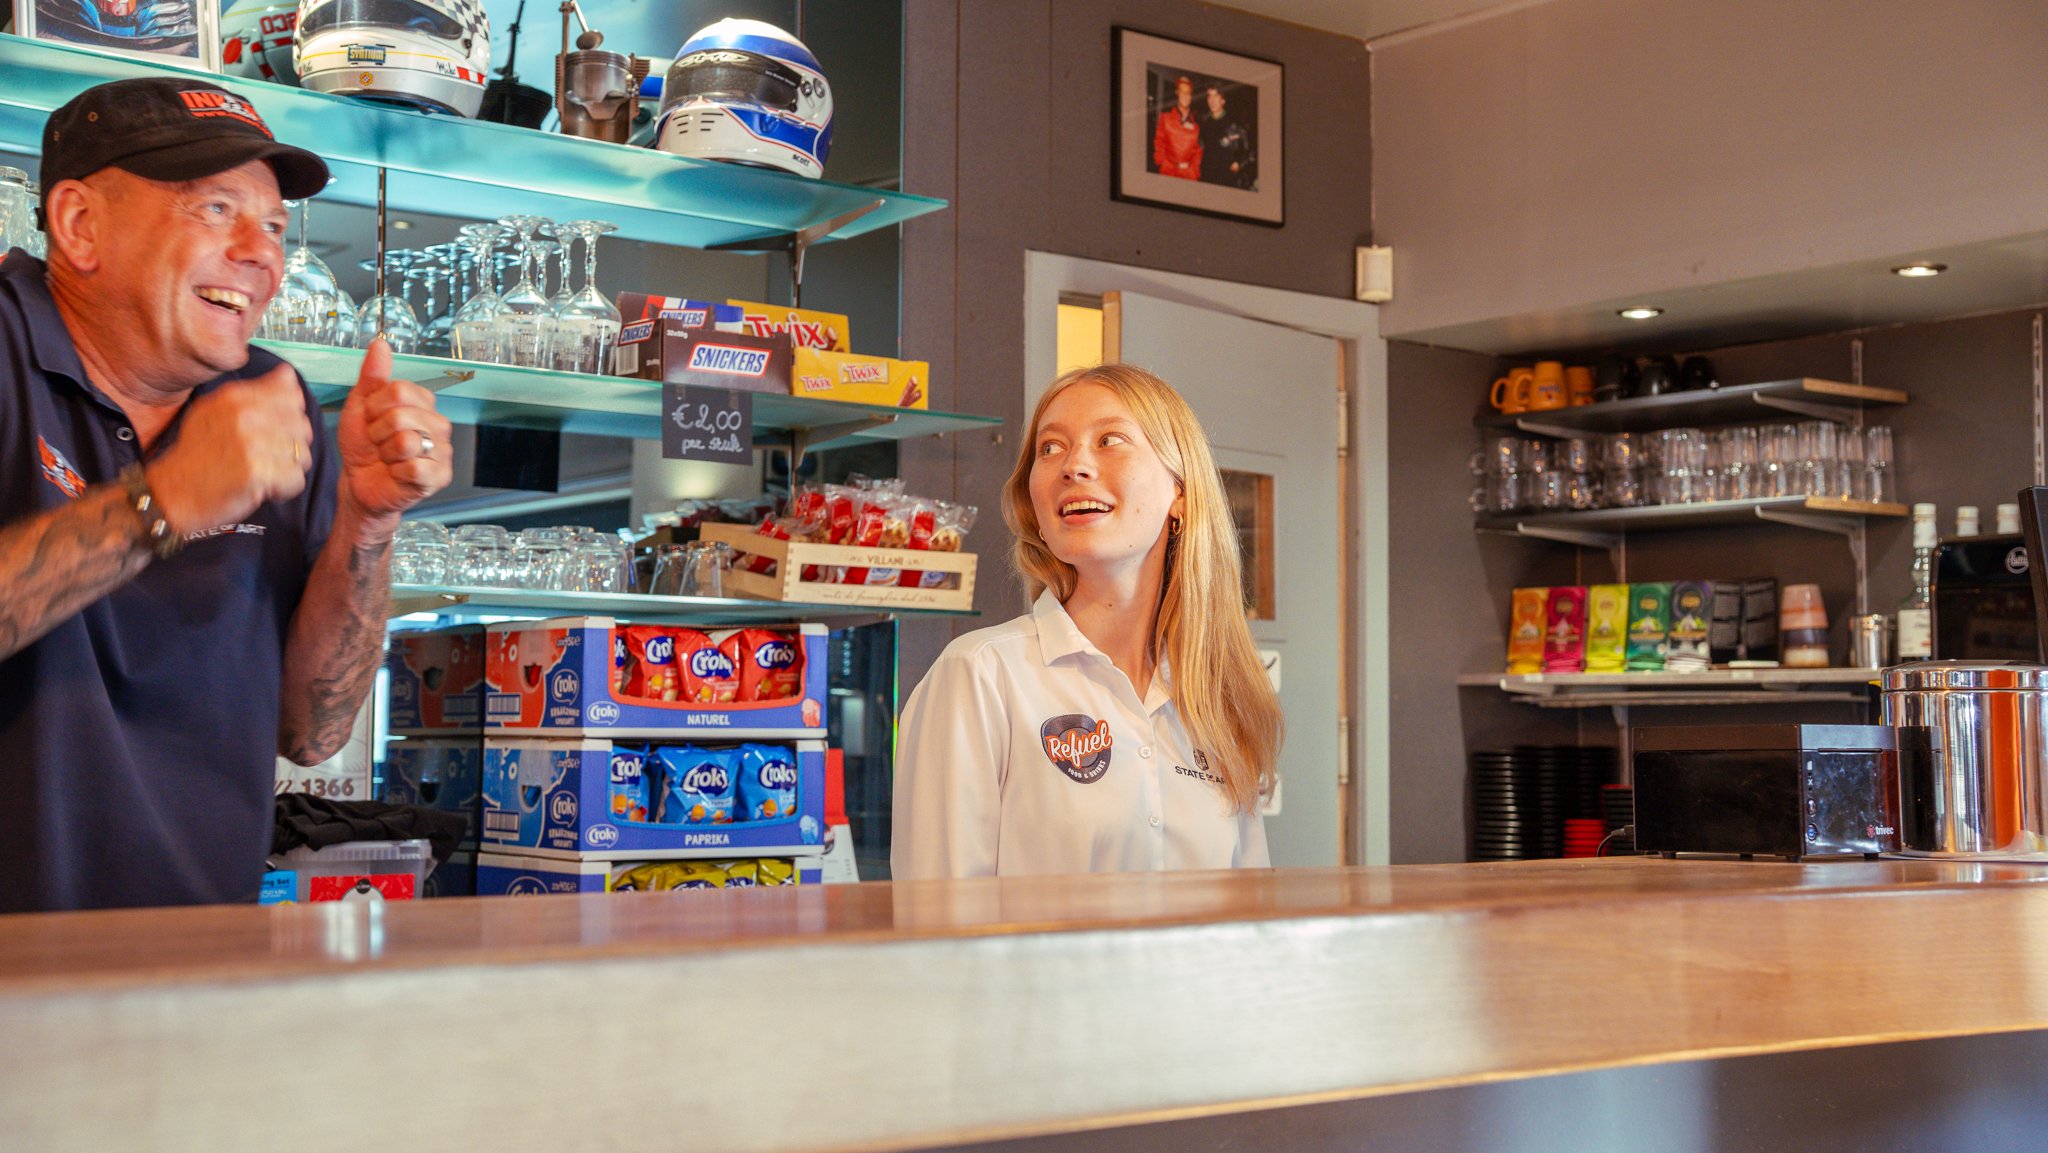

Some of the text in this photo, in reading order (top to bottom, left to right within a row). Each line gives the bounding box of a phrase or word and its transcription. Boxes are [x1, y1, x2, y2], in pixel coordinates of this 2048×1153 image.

[621, 324, 652, 343] SNICKERS
[693, 347, 765, 374] SNICKERS
[554, 675, 578, 698] Croky
[590, 705, 618, 721] Croky
[687, 714, 731, 726] NATUREL
[1048, 722, 1112, 768] Refuel
[761, 764, 797, 788] Croky
[1175, 765, 1206, 781] STATE
[553, 796, 577, 819] Croky
[588, 827, 617, 844] Croky
[1875, 825, 1894, 835] trivec
[685, 834, 730, 846] PAPRIKA
